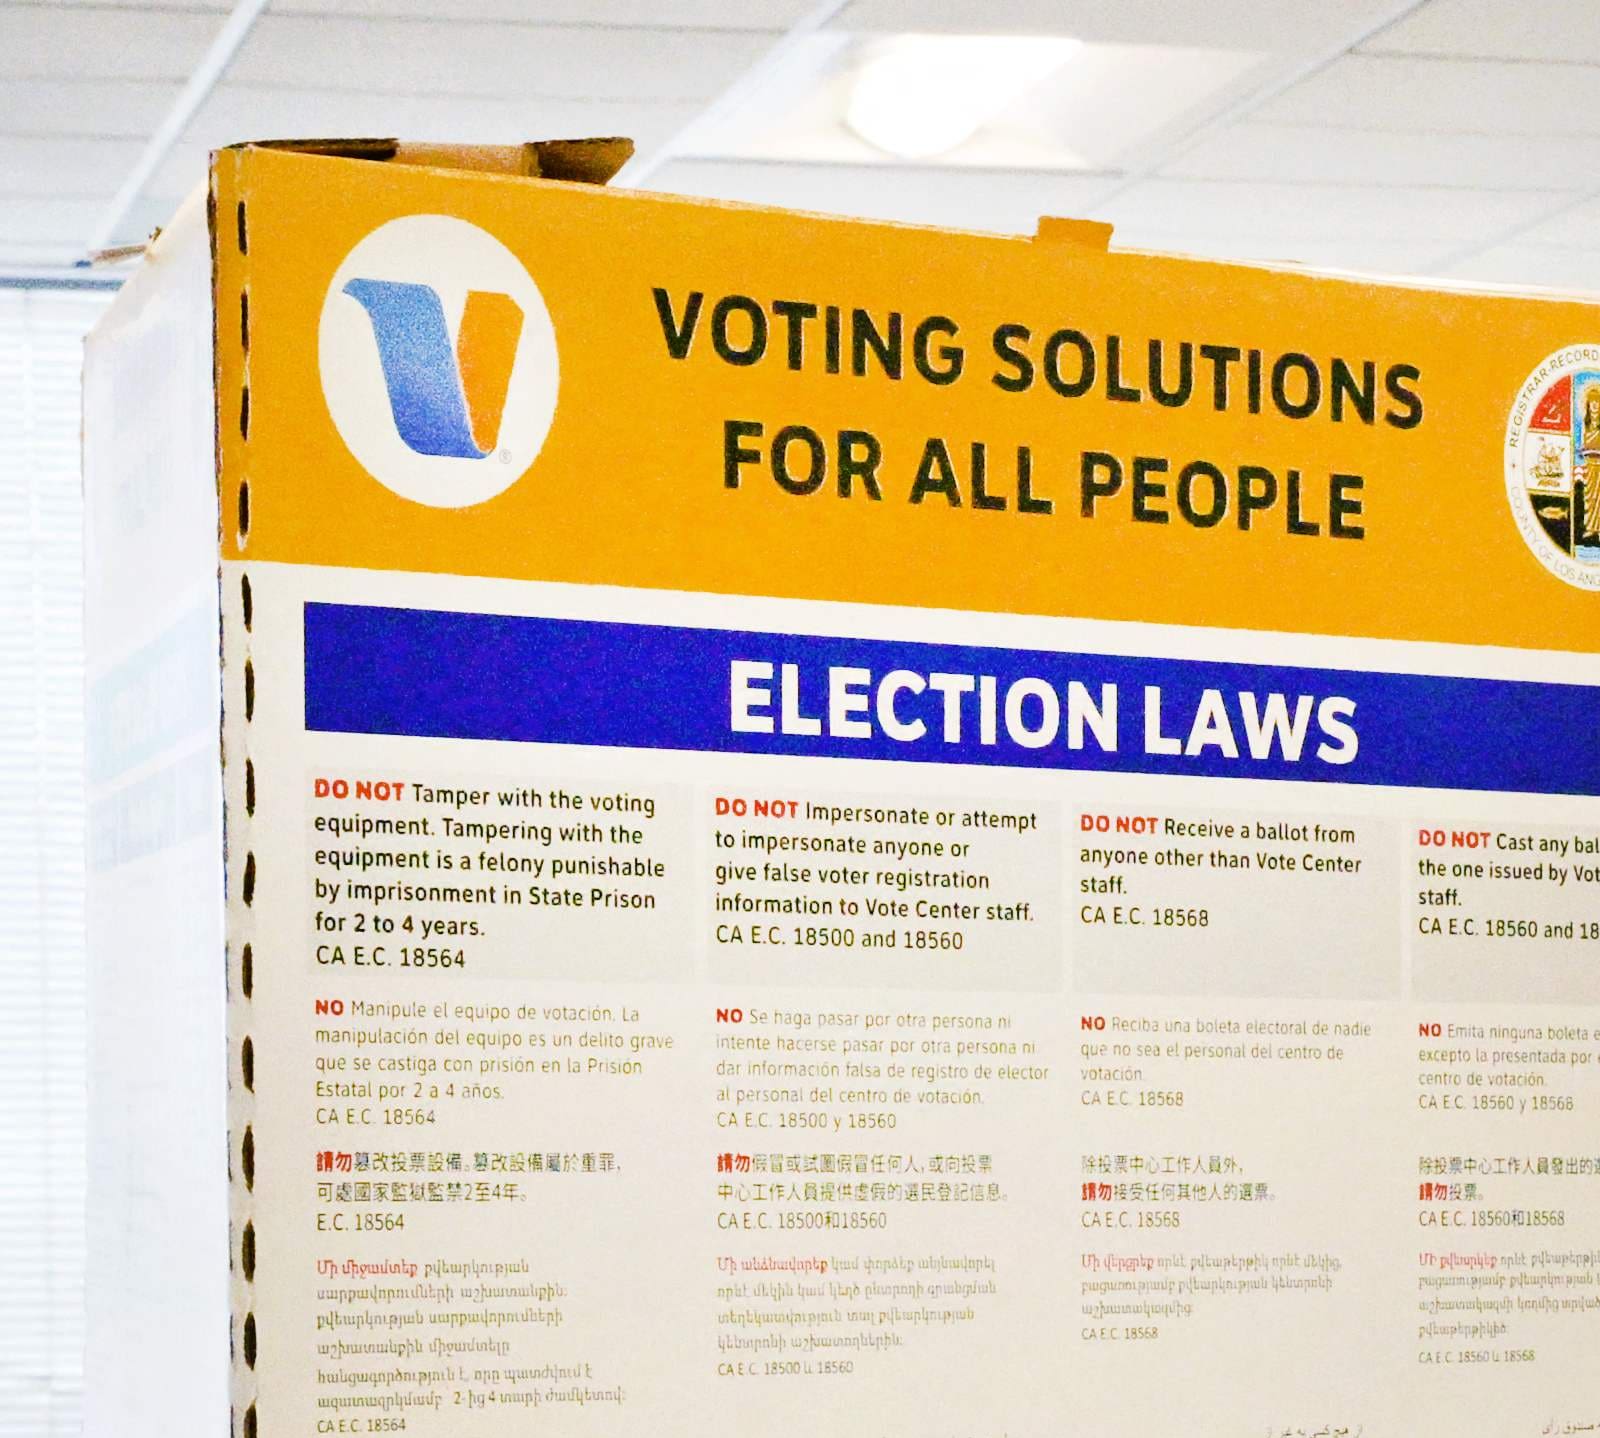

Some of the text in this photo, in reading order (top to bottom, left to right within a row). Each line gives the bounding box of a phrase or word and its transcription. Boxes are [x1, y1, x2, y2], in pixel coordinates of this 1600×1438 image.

[651, 288, 1424, 430] VOTING SOLUTIONS
[722, 420, 1365, 540] FOR ALL PEOPLE
[1554, 559, 1576, 581] LOS
[730, 658, 1360, 765] ELECTION LAWS
[315, 779, 654, 818] DO NOT Tamper with the voting
[716, 798, 1036, 834] DO NOT Impersonate or attempt
[1081, 814, 1354, 843] DO NOT Receive a ballot from
[315, 814, 642, 846] equipment. Tampering with the
[1419, 830, 1445, 846] DO
[1452, 832, 1491, 848] NOT
[1497, 833, 1533, 850] Cast
[1540, 839, 1568, 857] any
[716, 830, 969, 860] to impersonate anyone or
[315, 847, 664, 878] equipment is a felony punishable
[1081, 849, 1361, 872] anyone other than Vote Center
[1419, 859, 1446, 876] the
[1453, 864, 1483, 877] one
[1490, 864, 1542, 880] issued
[1549, 864, 1567, 886] by
[716, 861, 988, 891] give false voter registration
[1081, 876, 1127, 894] staff.
[316, 878, 654, 908] by imprisonment in State Prison
[716, 893, 1033, 920] information to Vote Center staff.
[1419, 889, 1462, 905] staff.
[316, 911, 484, 940] for 2 to 4 years.
[1081, 906, 1208, 927] CA E.C. 18568
[1419, 917, 1441, 934] CA
[1449, 919, 1479, 935] E.C.
[1486, 920, 1537, 937] 18560
[1544, 922, 1573, 939] and
[717, 925, 962, 949] CA E.C. 18500 and 18560
[317, 946, 464, 968] CA E.C. 18564
[316, 1000, 343, 1015] NO
[352, 1000, 426, 1020] Manipule
[434, 1002, 448, 1018] el
[455, 1006, 510, 1022] equipo
[518, 1005, 536, 1019] de
[623, 1008, 639, 1022] La
[317, 1213, 404, 1231] E.C. 18564
